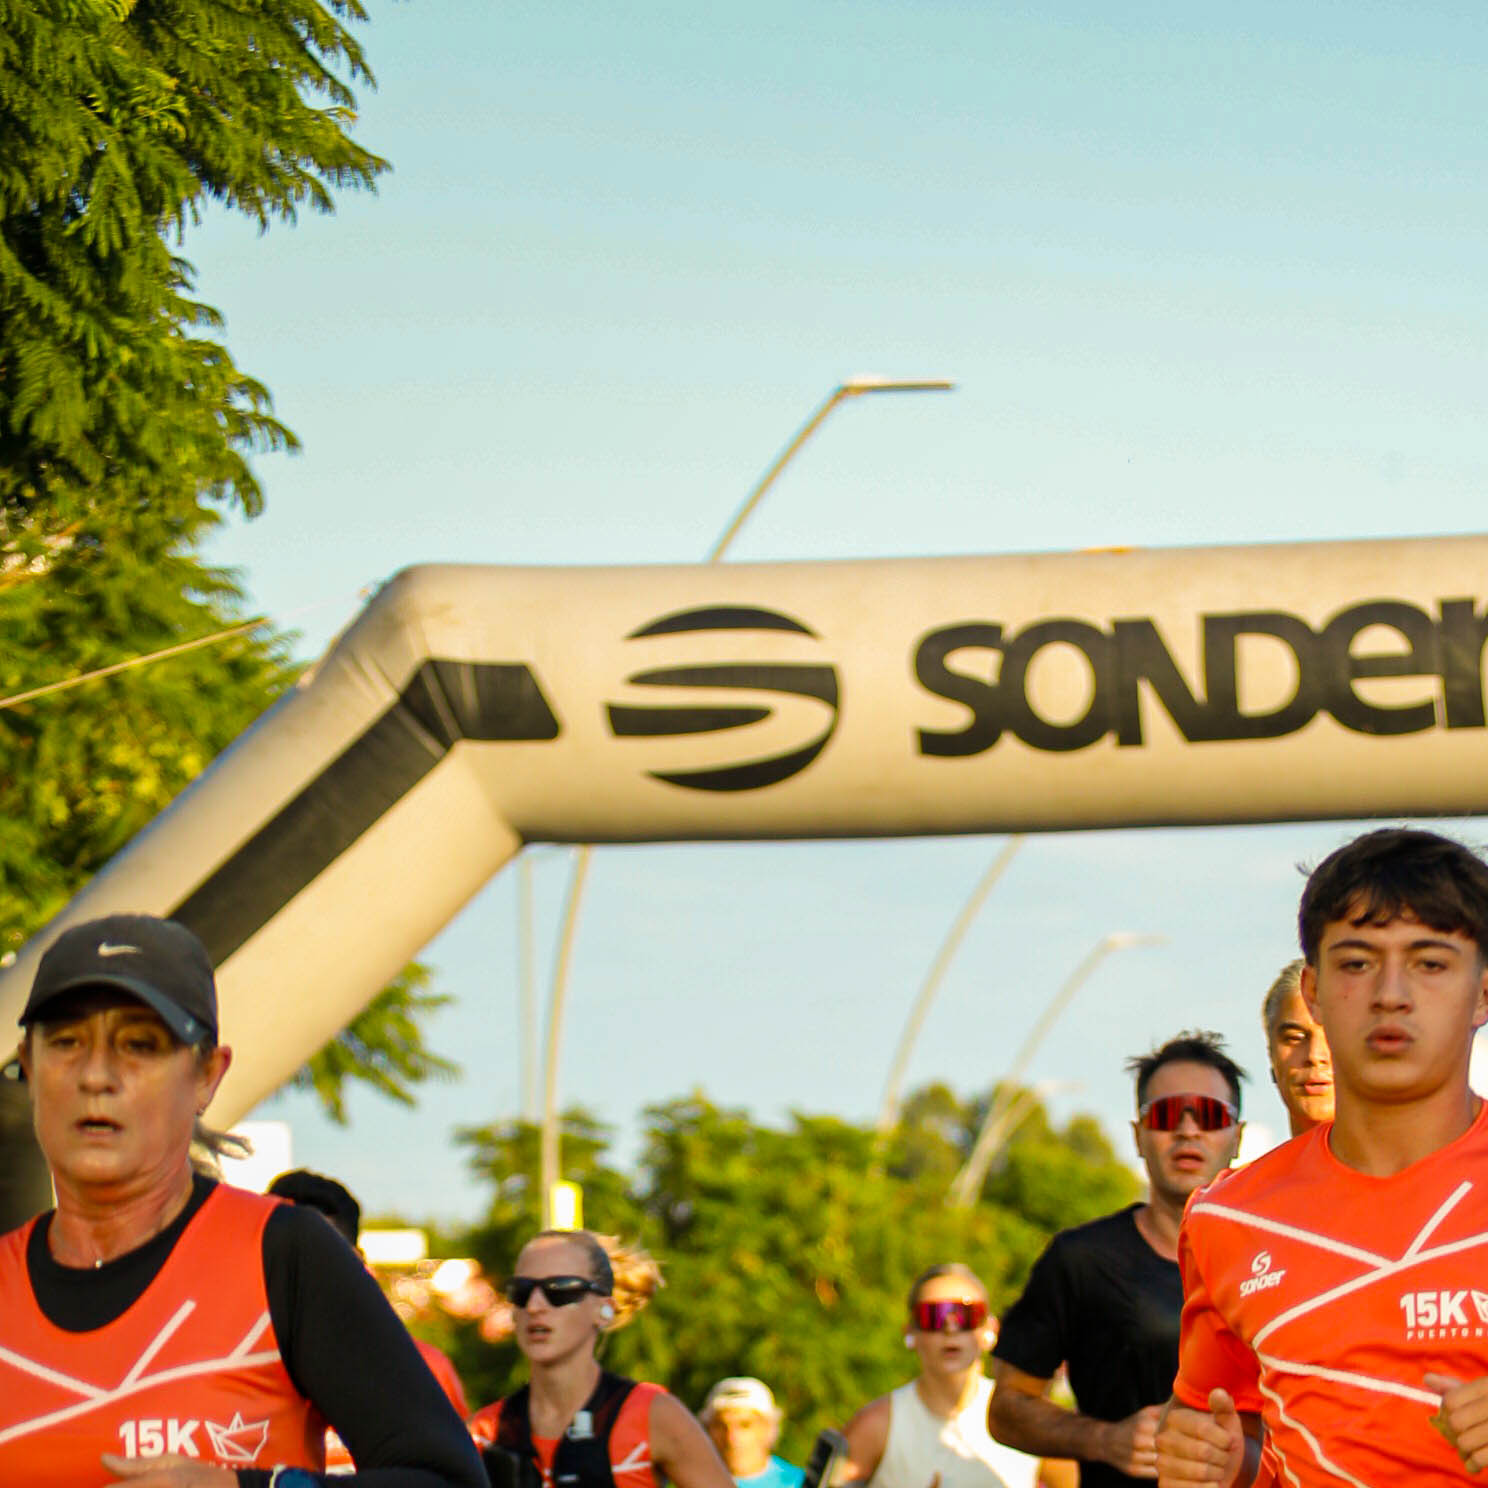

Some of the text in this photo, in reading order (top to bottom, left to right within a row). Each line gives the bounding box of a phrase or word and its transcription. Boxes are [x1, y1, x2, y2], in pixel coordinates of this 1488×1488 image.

[1400, 1290, 1468, 1330] 15K
[1406, 1328, 1469, 1341] PUERTO
[119, 1418, 200, 1459] 15K
